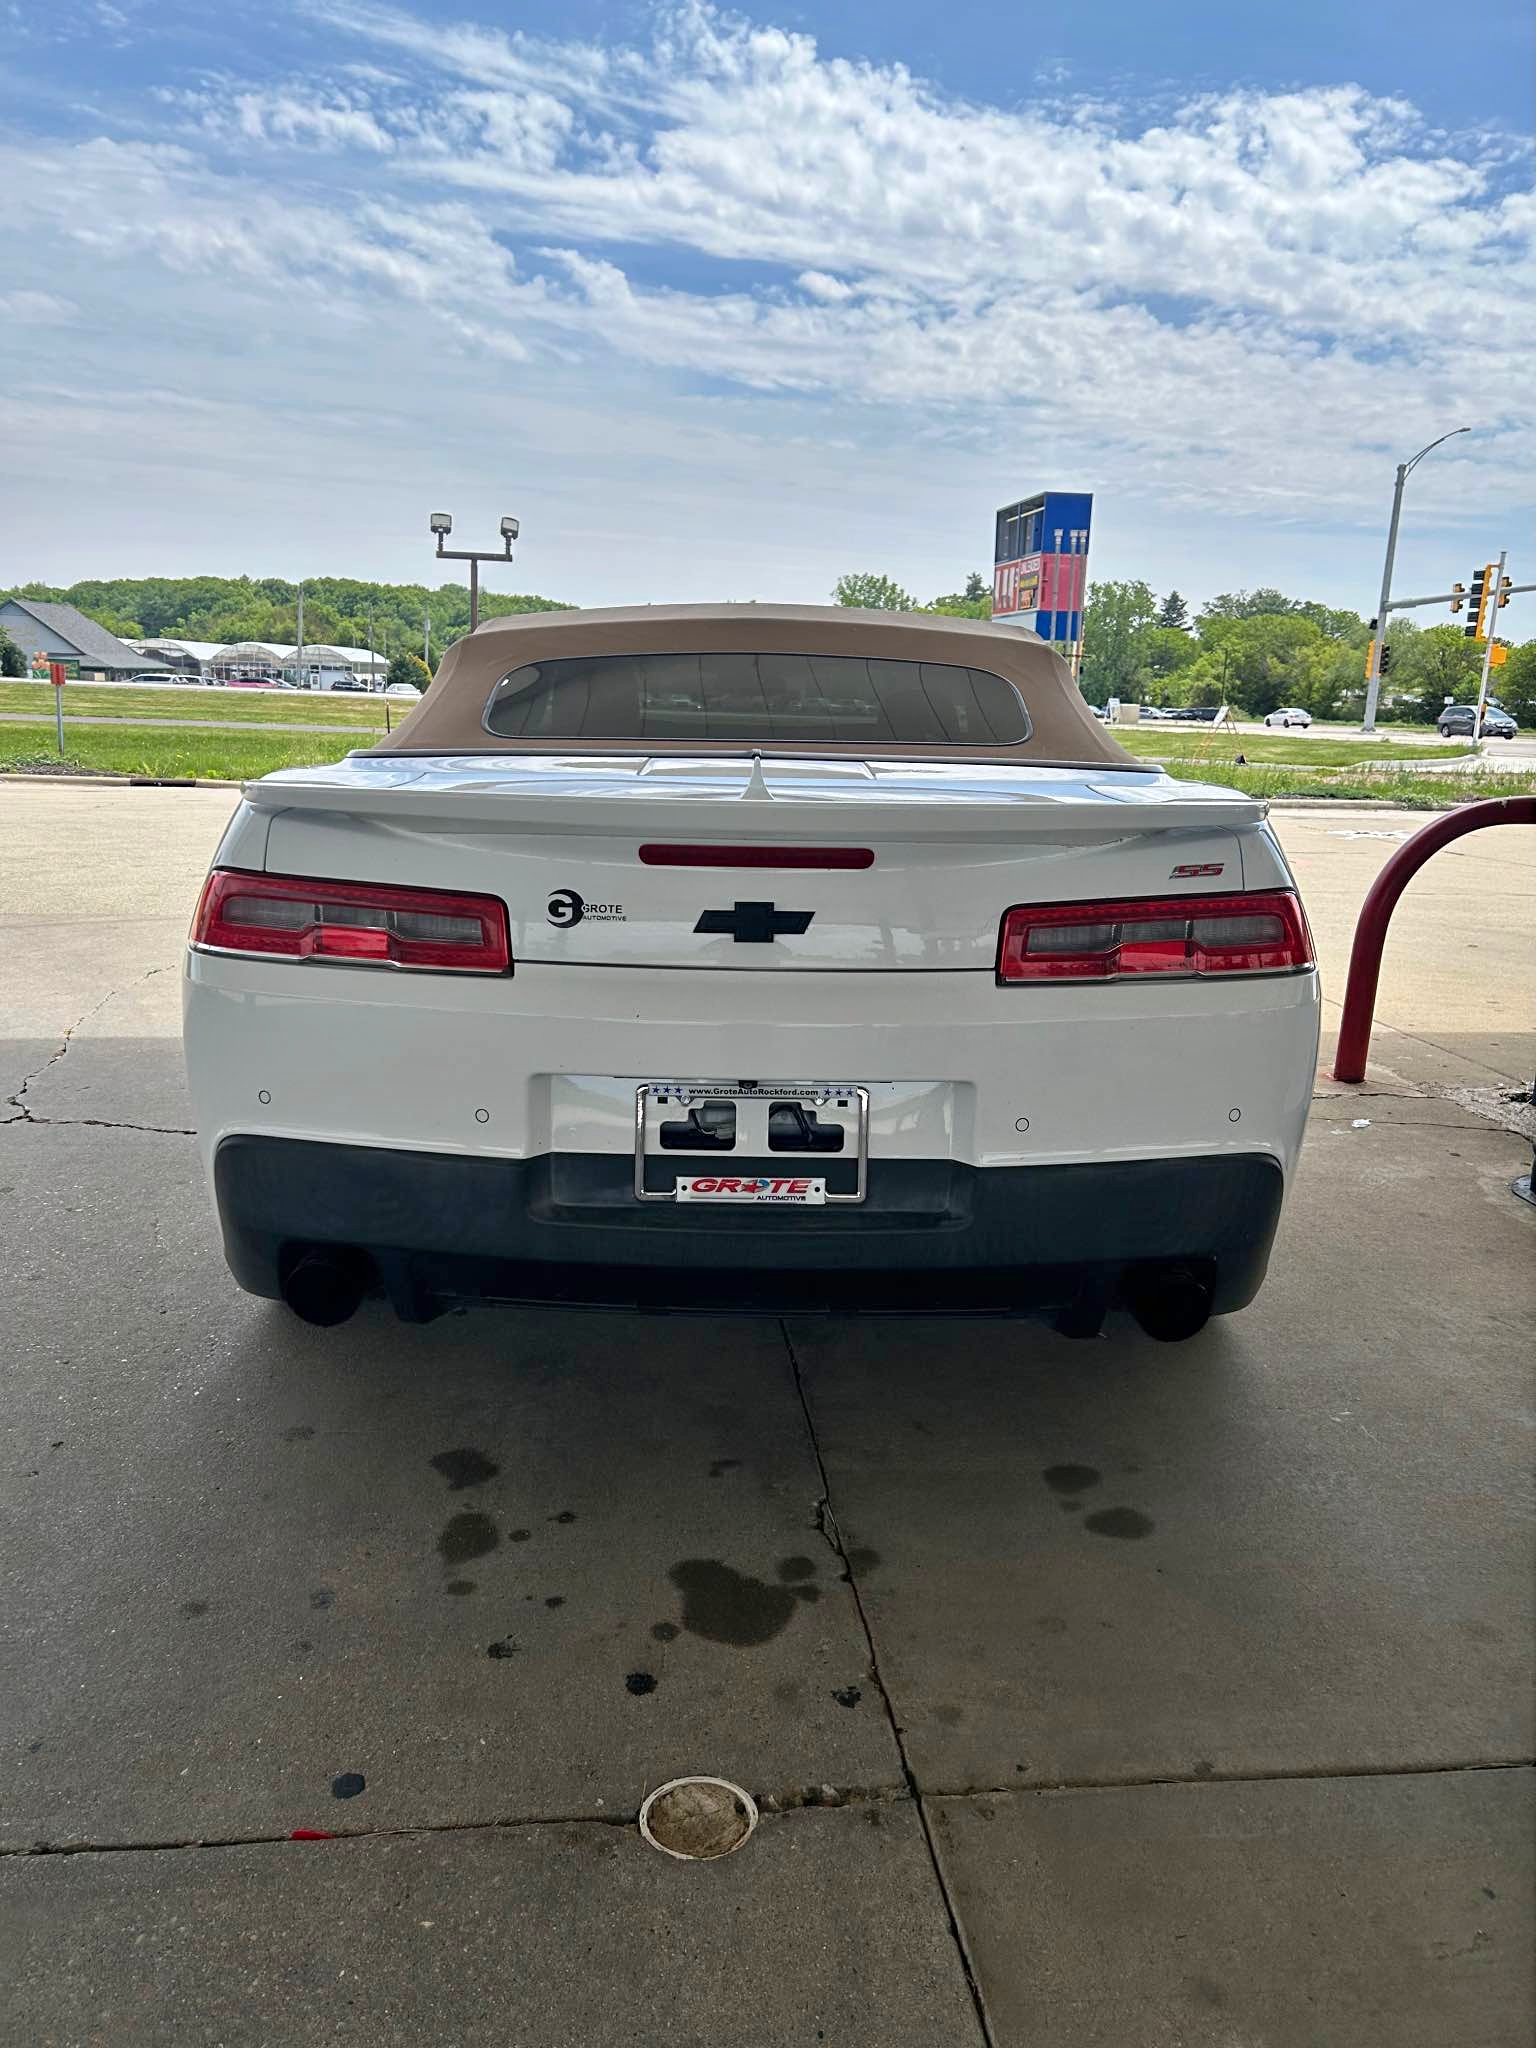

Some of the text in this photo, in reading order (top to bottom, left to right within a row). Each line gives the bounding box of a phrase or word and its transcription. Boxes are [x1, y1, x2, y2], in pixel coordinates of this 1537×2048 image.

[1168, 863, 1224, 879] SS
[582, 904, 623, 914] GROTE
[688, 1088, 819, 1096] www.GroteAutoRockford.com
